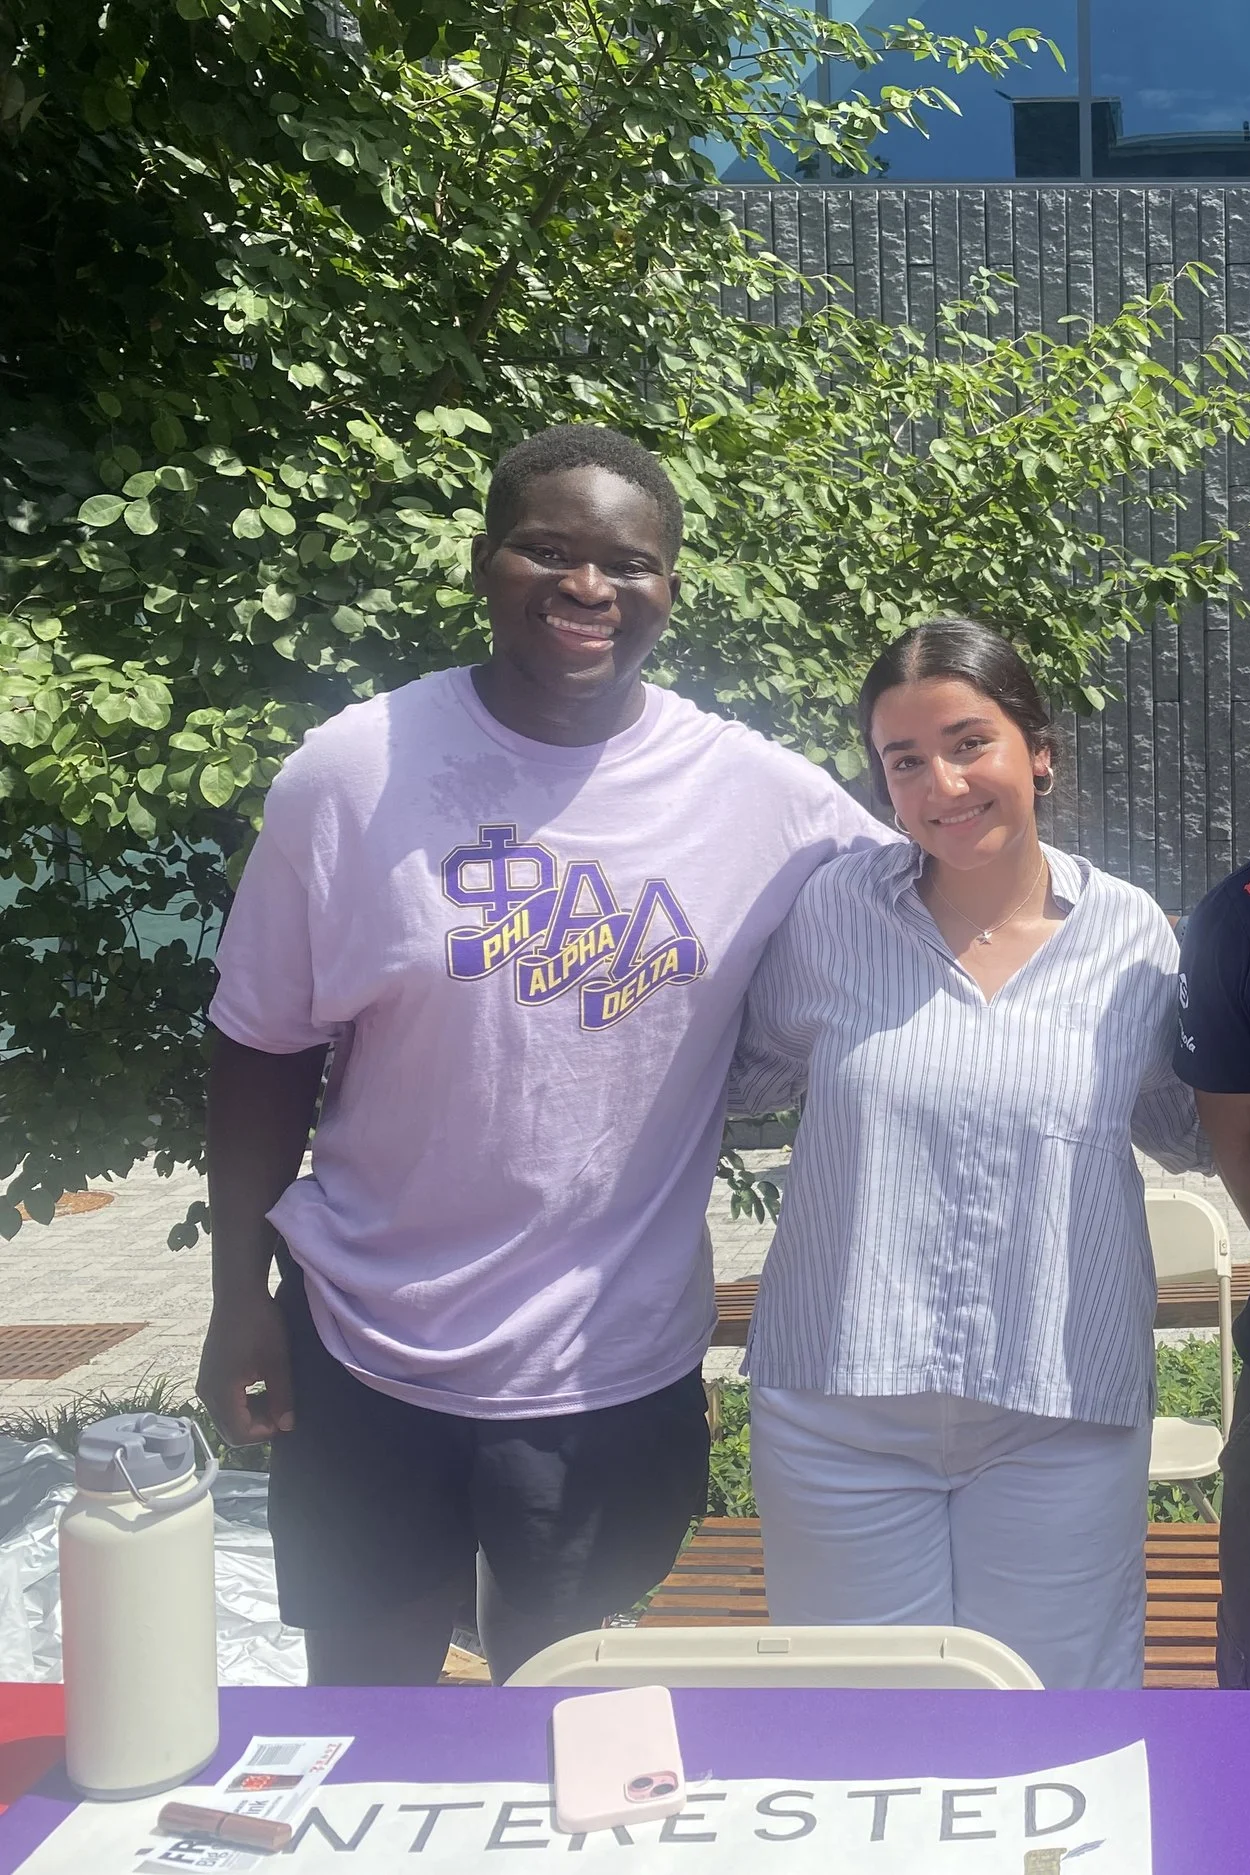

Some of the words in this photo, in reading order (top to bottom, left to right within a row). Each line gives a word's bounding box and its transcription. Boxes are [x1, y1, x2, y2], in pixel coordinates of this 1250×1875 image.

[482, 909, 530, 969] PHI
[529, 923, 615, 997] ALPHA
[602, 947, 679, 1020] DELTA
